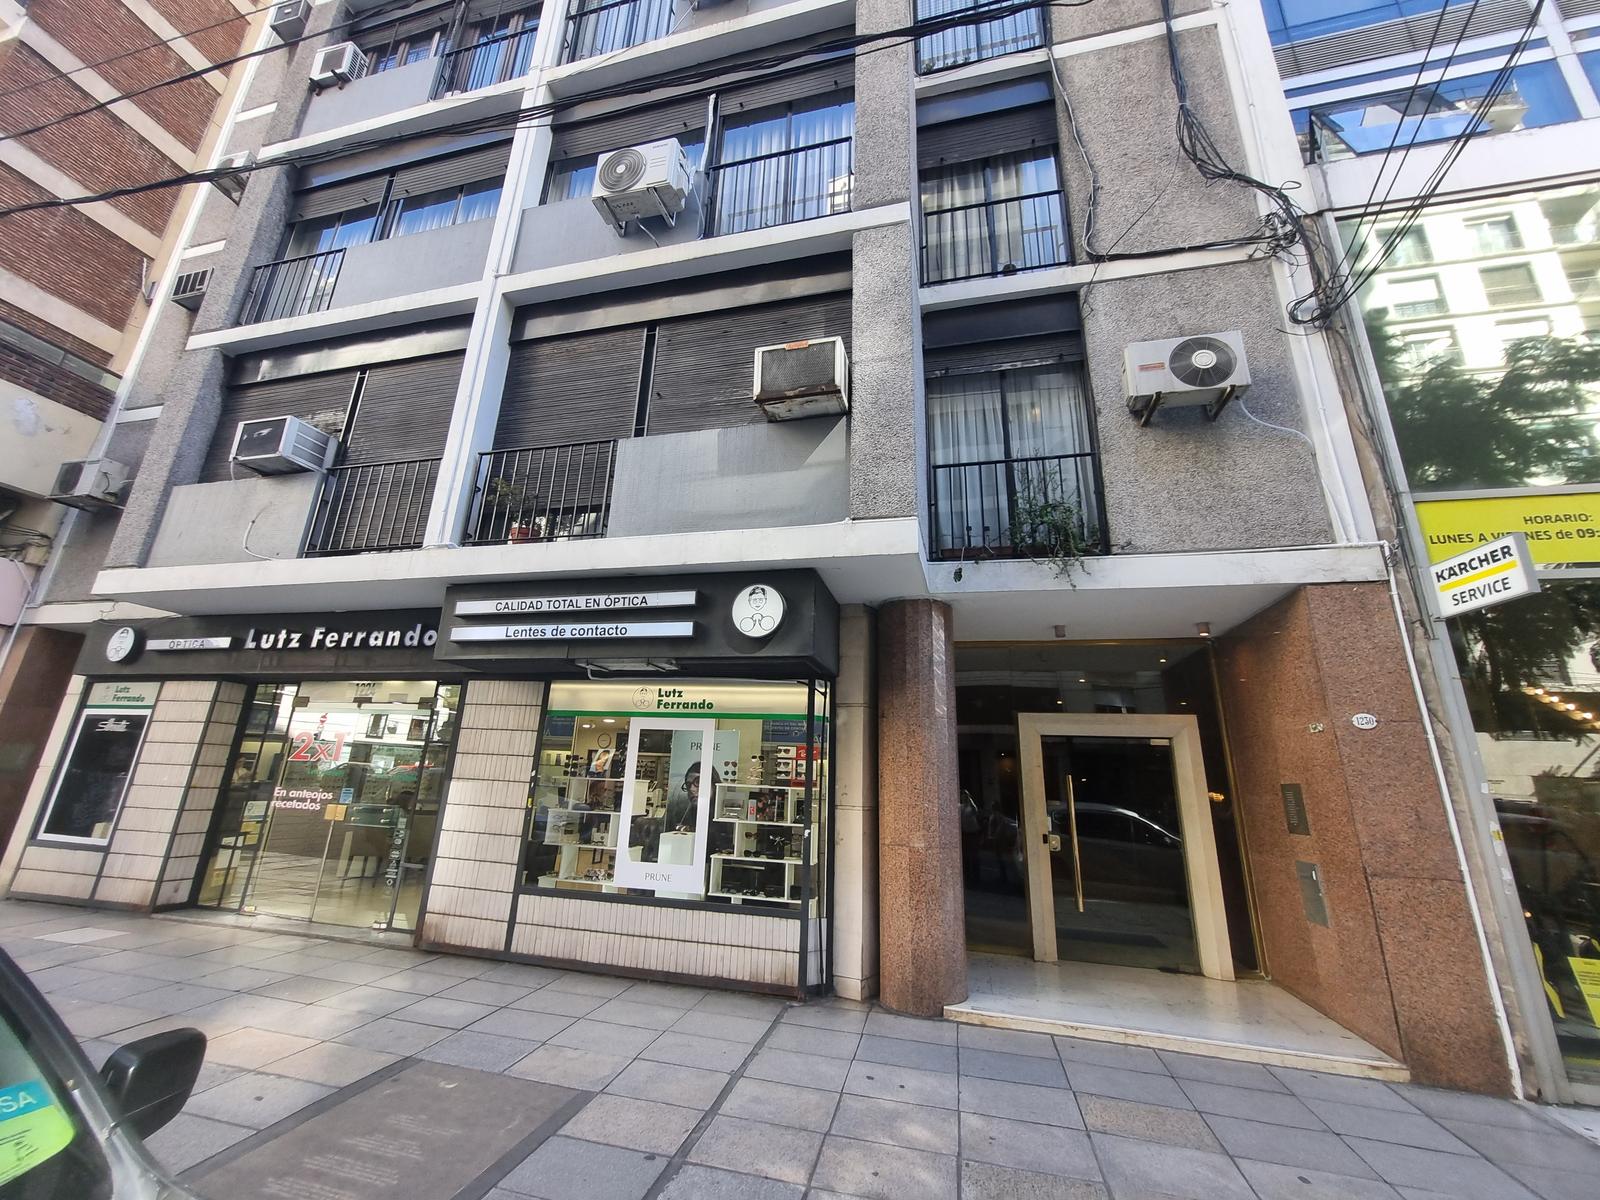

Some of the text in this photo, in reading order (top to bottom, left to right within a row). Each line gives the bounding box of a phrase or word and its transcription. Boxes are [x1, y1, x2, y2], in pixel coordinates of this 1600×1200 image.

[1523, 513, 1593, 524] HORARIO:
[1429, 533, 1474, 544] LUNES
[1478, 532, 1488, 542] A
[1556, 530, 1573, 539] de
[1435, 545, 1513, 583] KÄRCHER
[1451, 576, 1512, 606] SERVICE
[495, 594, 648, 612] CALIDAD TOTAL EN ÓPTICA
[244, 624, 438, 649] Lutz Ferrando
[505, 625, 628, 638] Lentes de contacto
[658, 688, 683, 698] Lutz
[657, 699, 714, 710] Ferrando
[1356, 717, 1375, 726] 1230
[288, 731, 347, 762] 2x1
[274, 786, 333, 800] En anteojos
[271, 798, 321, 811] recetados
